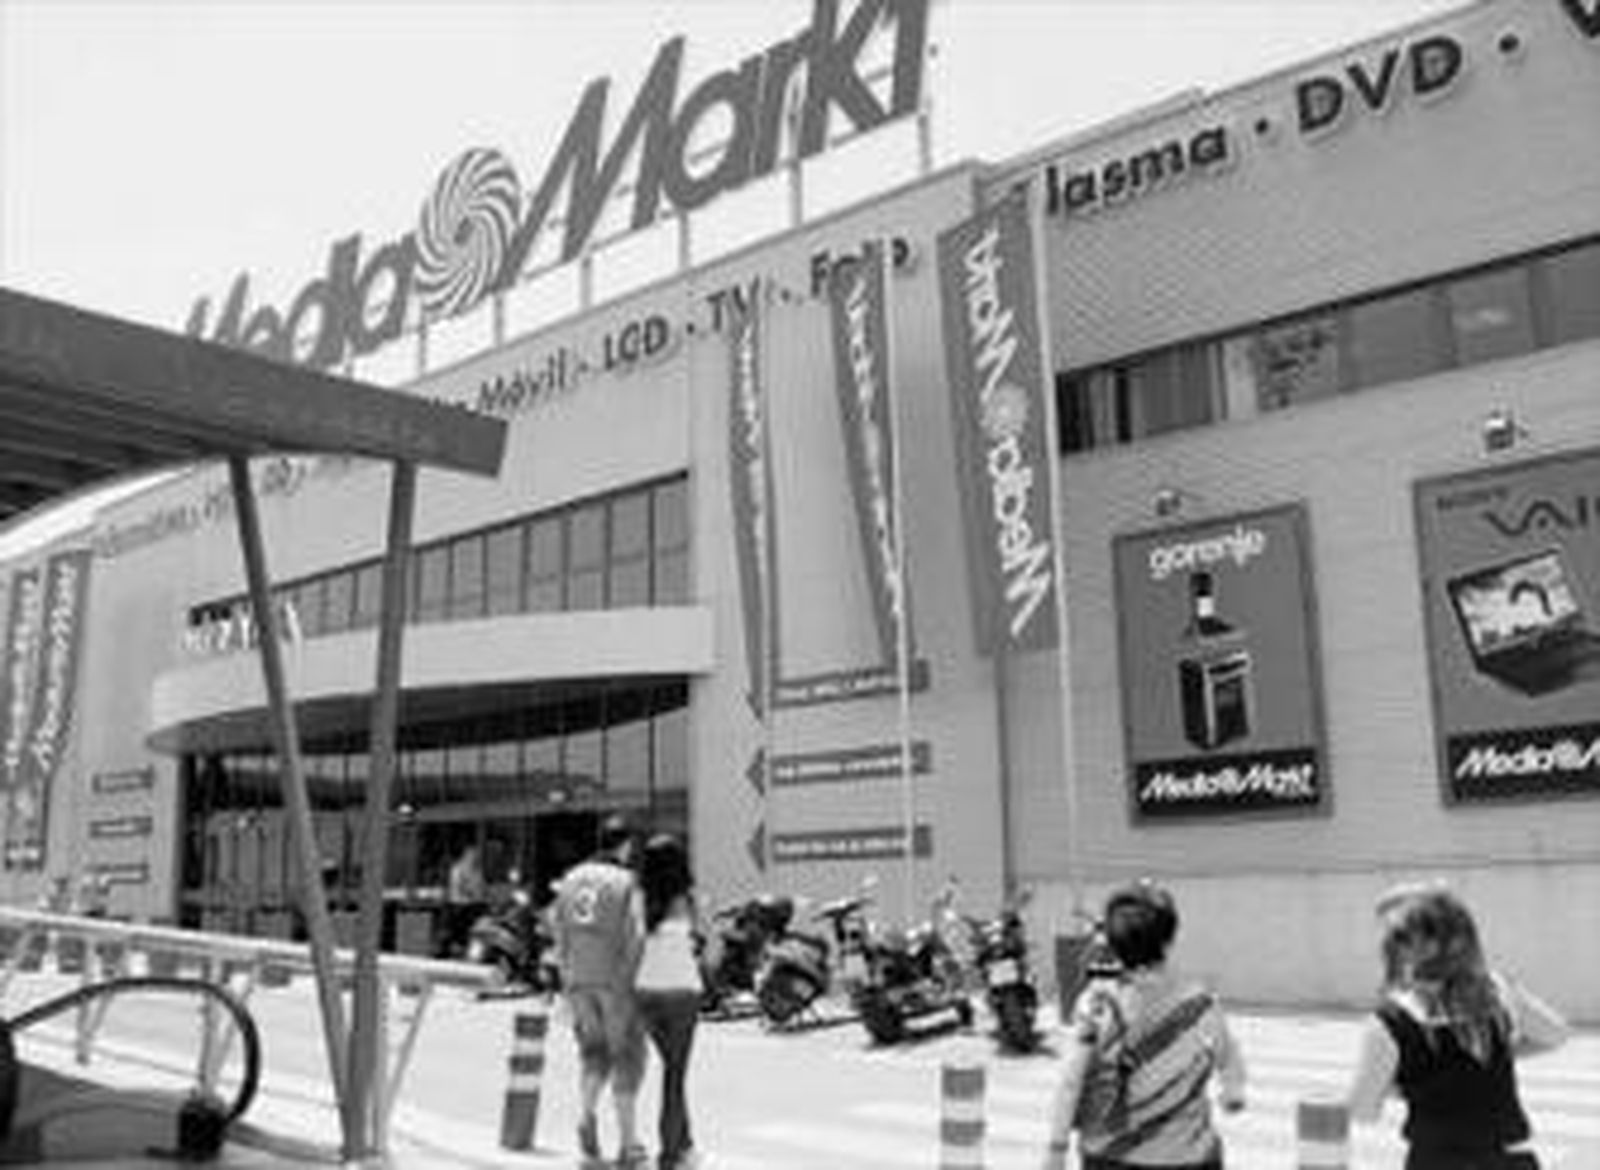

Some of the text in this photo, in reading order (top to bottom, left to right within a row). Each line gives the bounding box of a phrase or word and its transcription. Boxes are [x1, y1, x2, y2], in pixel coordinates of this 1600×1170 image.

[1044, 125, 1227, 215] lasma
[1295, 36, 1463, 133] DVD
[604, 316, 669, 371] LCD
[1481, 496, 1600, 535] VAI
